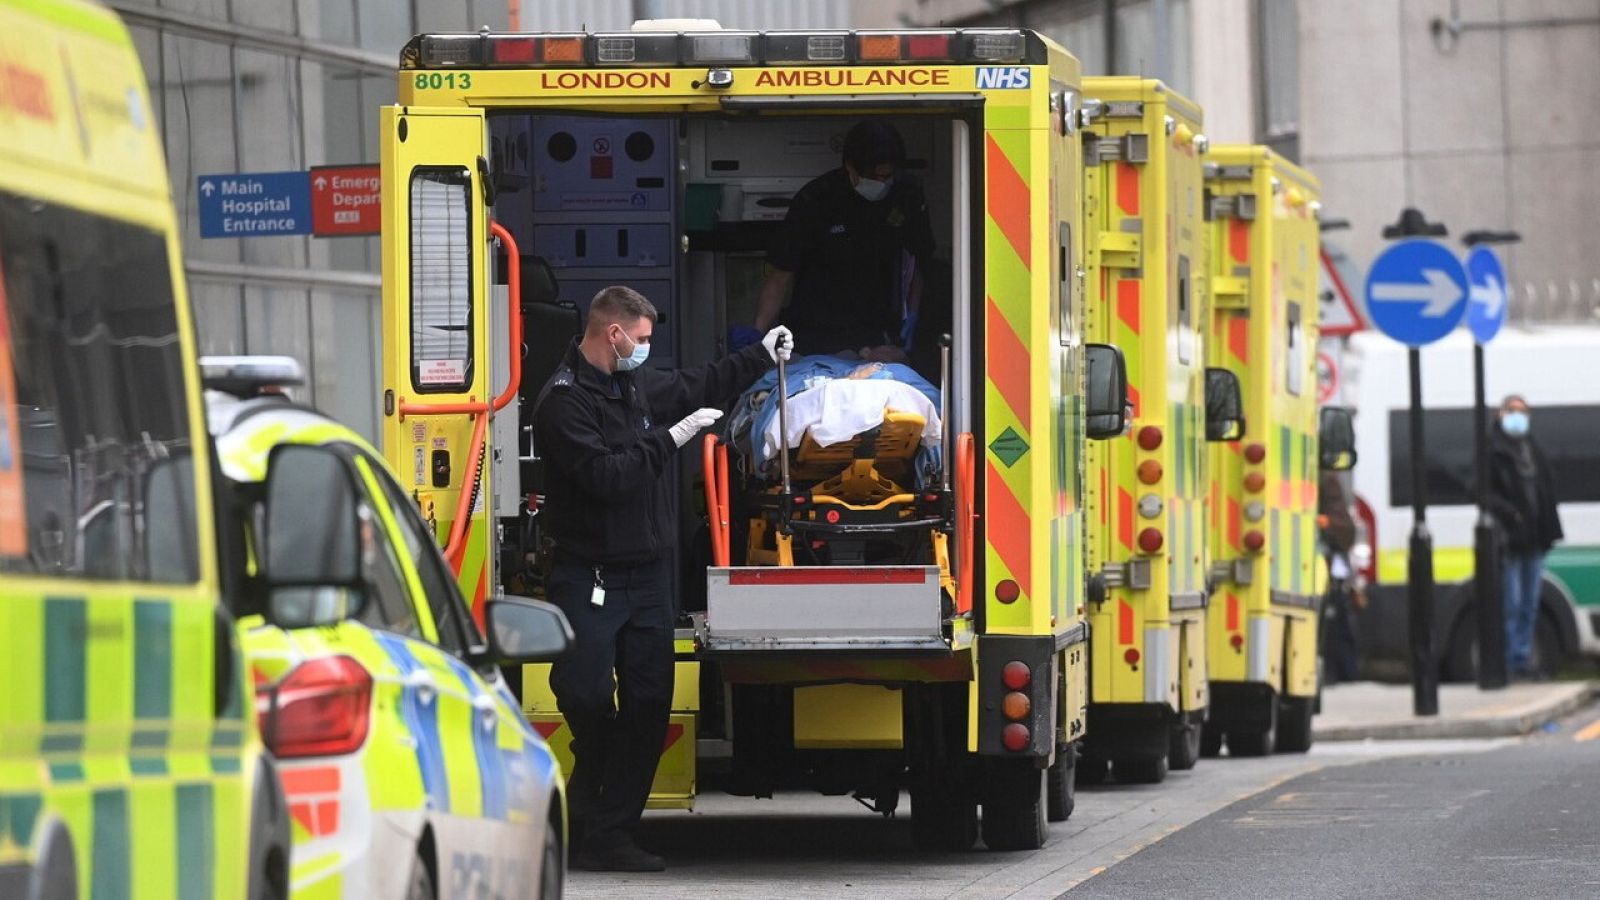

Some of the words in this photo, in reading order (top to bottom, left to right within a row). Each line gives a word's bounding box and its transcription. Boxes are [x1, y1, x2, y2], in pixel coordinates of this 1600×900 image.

[415, 73, 471, 90] 8013
[541, 72, 671, 89] LONDON
[755, 69, 950, 87] AMBULANCE
[976, 68, 1029, 88] NHS
[221, 180, 263, 195] Main
[222, 197, 290, 215] Hospital
[223, 218, 295, 232] Entrance
